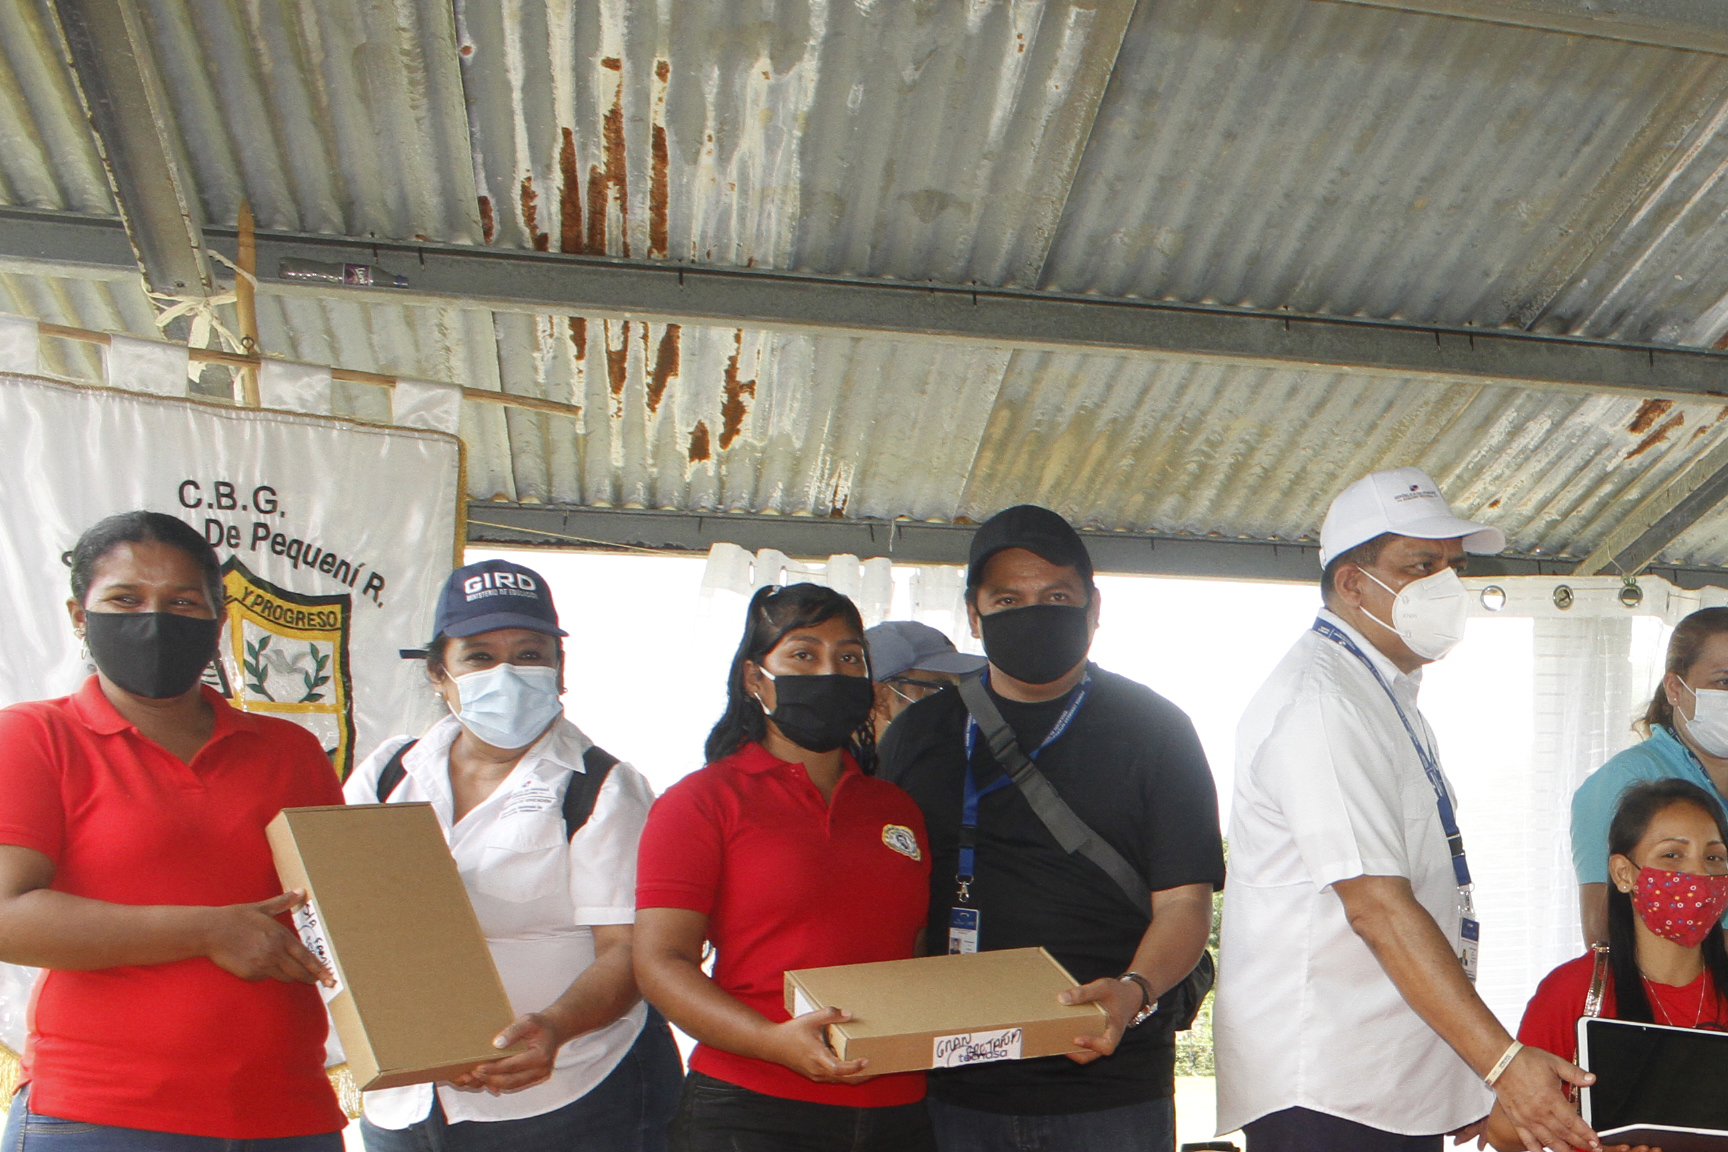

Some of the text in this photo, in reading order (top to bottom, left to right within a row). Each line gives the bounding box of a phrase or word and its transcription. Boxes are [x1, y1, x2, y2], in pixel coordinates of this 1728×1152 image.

[178, 479, 285, 518] C.B.G.
[205, 518, 385, 608] De Pequení R.
[464, 572, 537, 595] GIRD
[250, 593, 338, 628] PROGRESO
